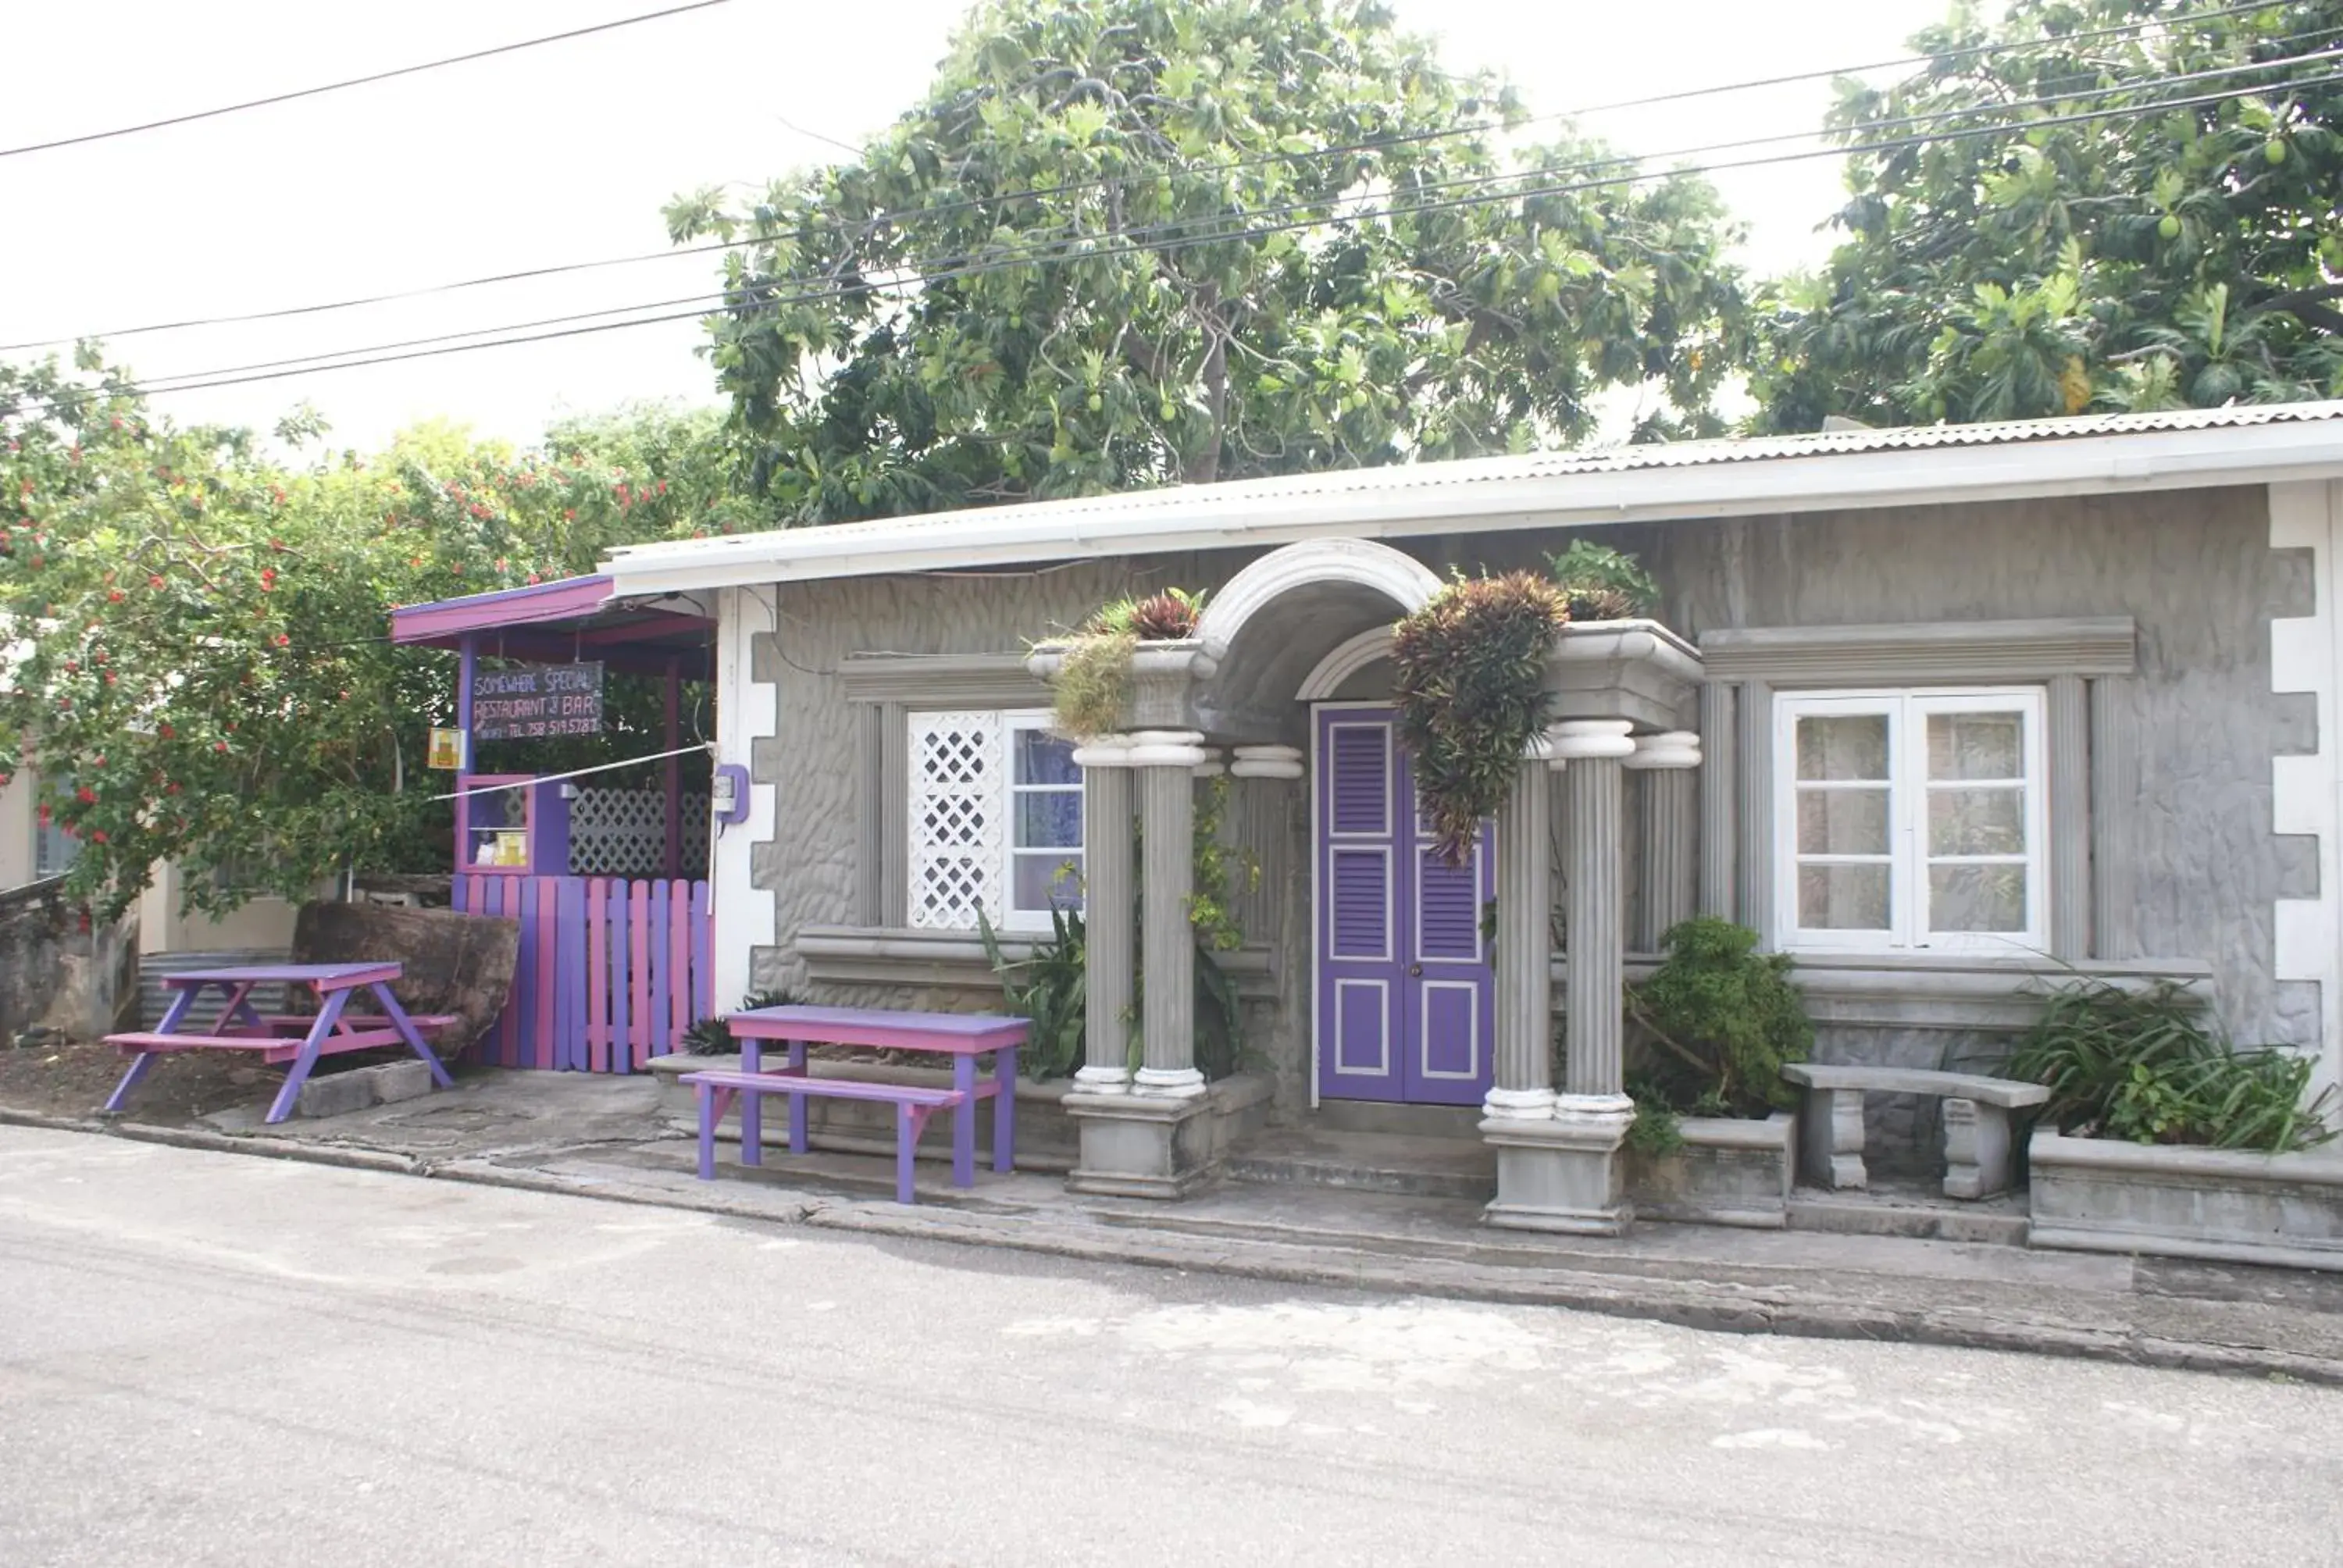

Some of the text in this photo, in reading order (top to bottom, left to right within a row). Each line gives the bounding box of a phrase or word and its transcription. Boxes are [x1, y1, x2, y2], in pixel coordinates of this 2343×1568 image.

[474, 671, 592, 696] SOMEWHERE SPECIAL
[474, 697, 547, 718] RESTAURANT
[562, 696, 594, 715] BAR
[528, 722, 546, 736] 758
[549, 721, 566, 734] 519
